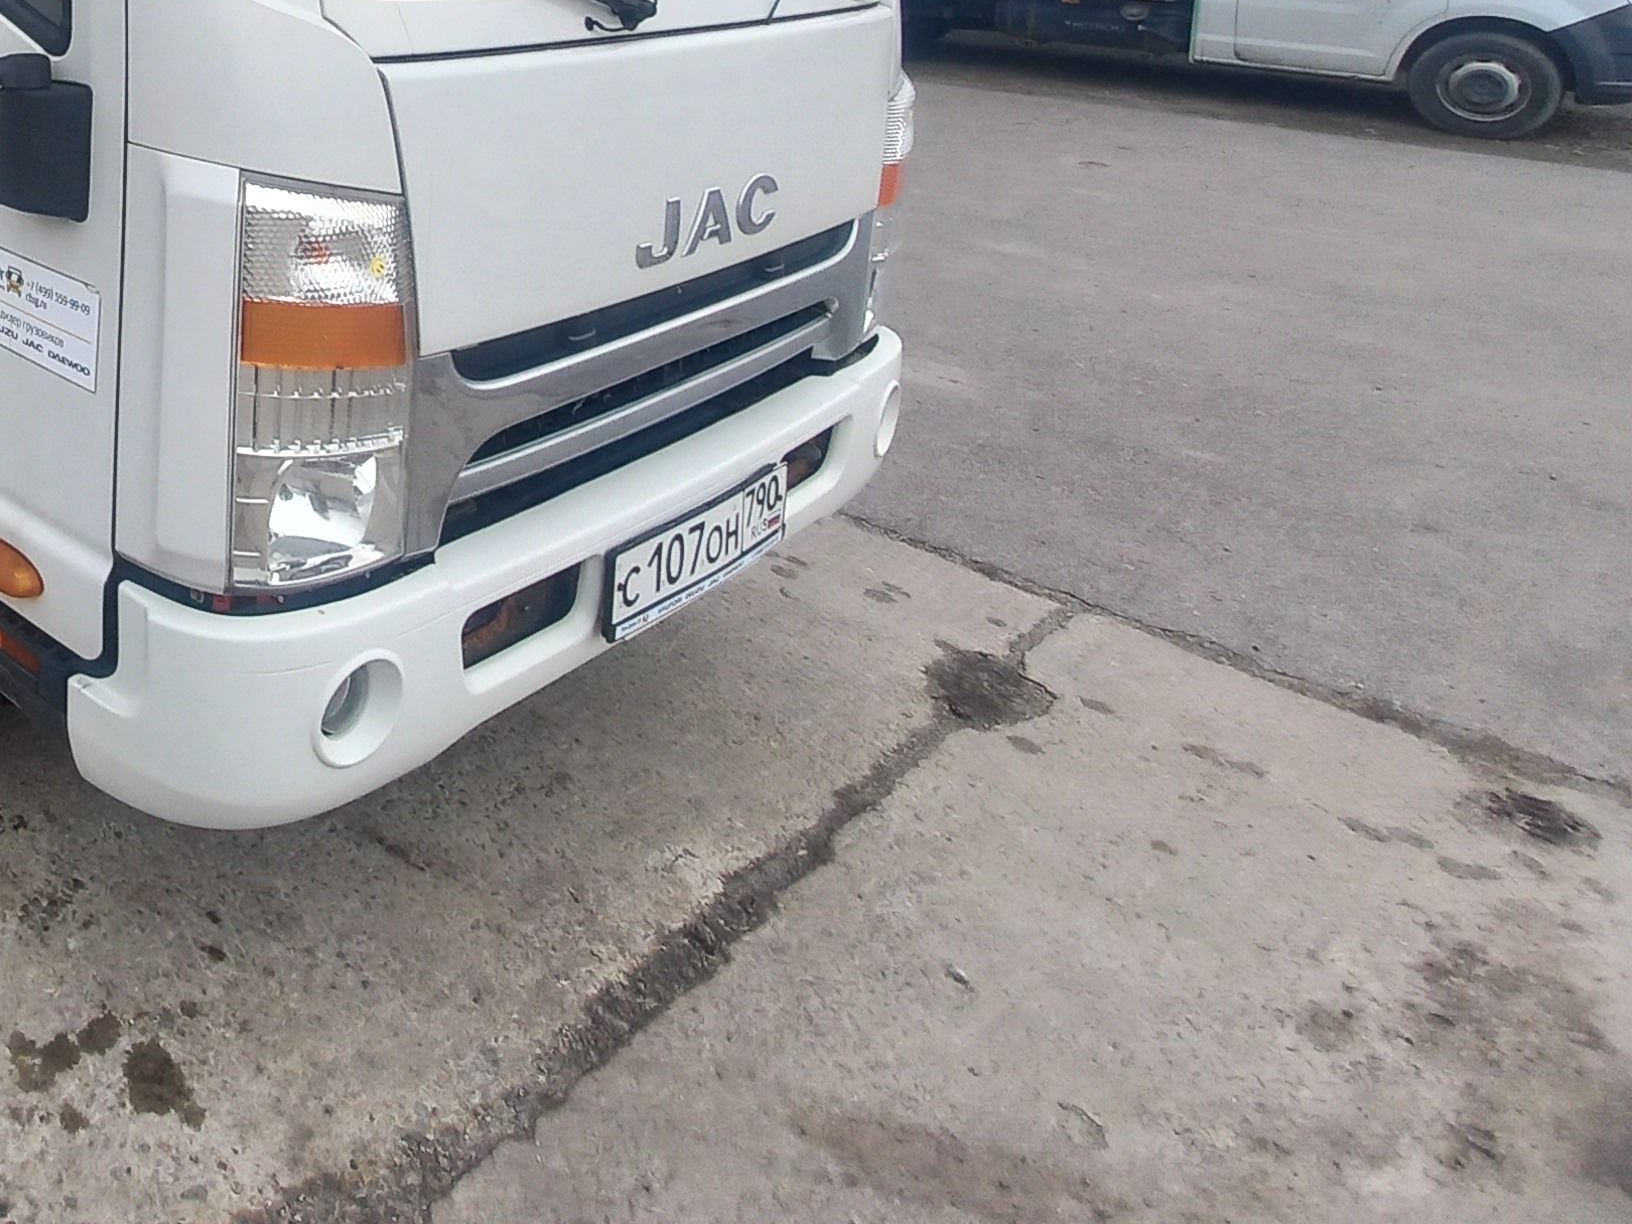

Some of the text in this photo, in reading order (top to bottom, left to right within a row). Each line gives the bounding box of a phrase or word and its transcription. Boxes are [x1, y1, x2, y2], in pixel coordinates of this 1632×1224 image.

[635, 172, 779, 269] JAC
[23, 338, 44, 353] JAC
[48, 349, 91, 377] DAEWOO
[745, 474, 780, 527] 790
[751, 517, 768, 541] RUS
